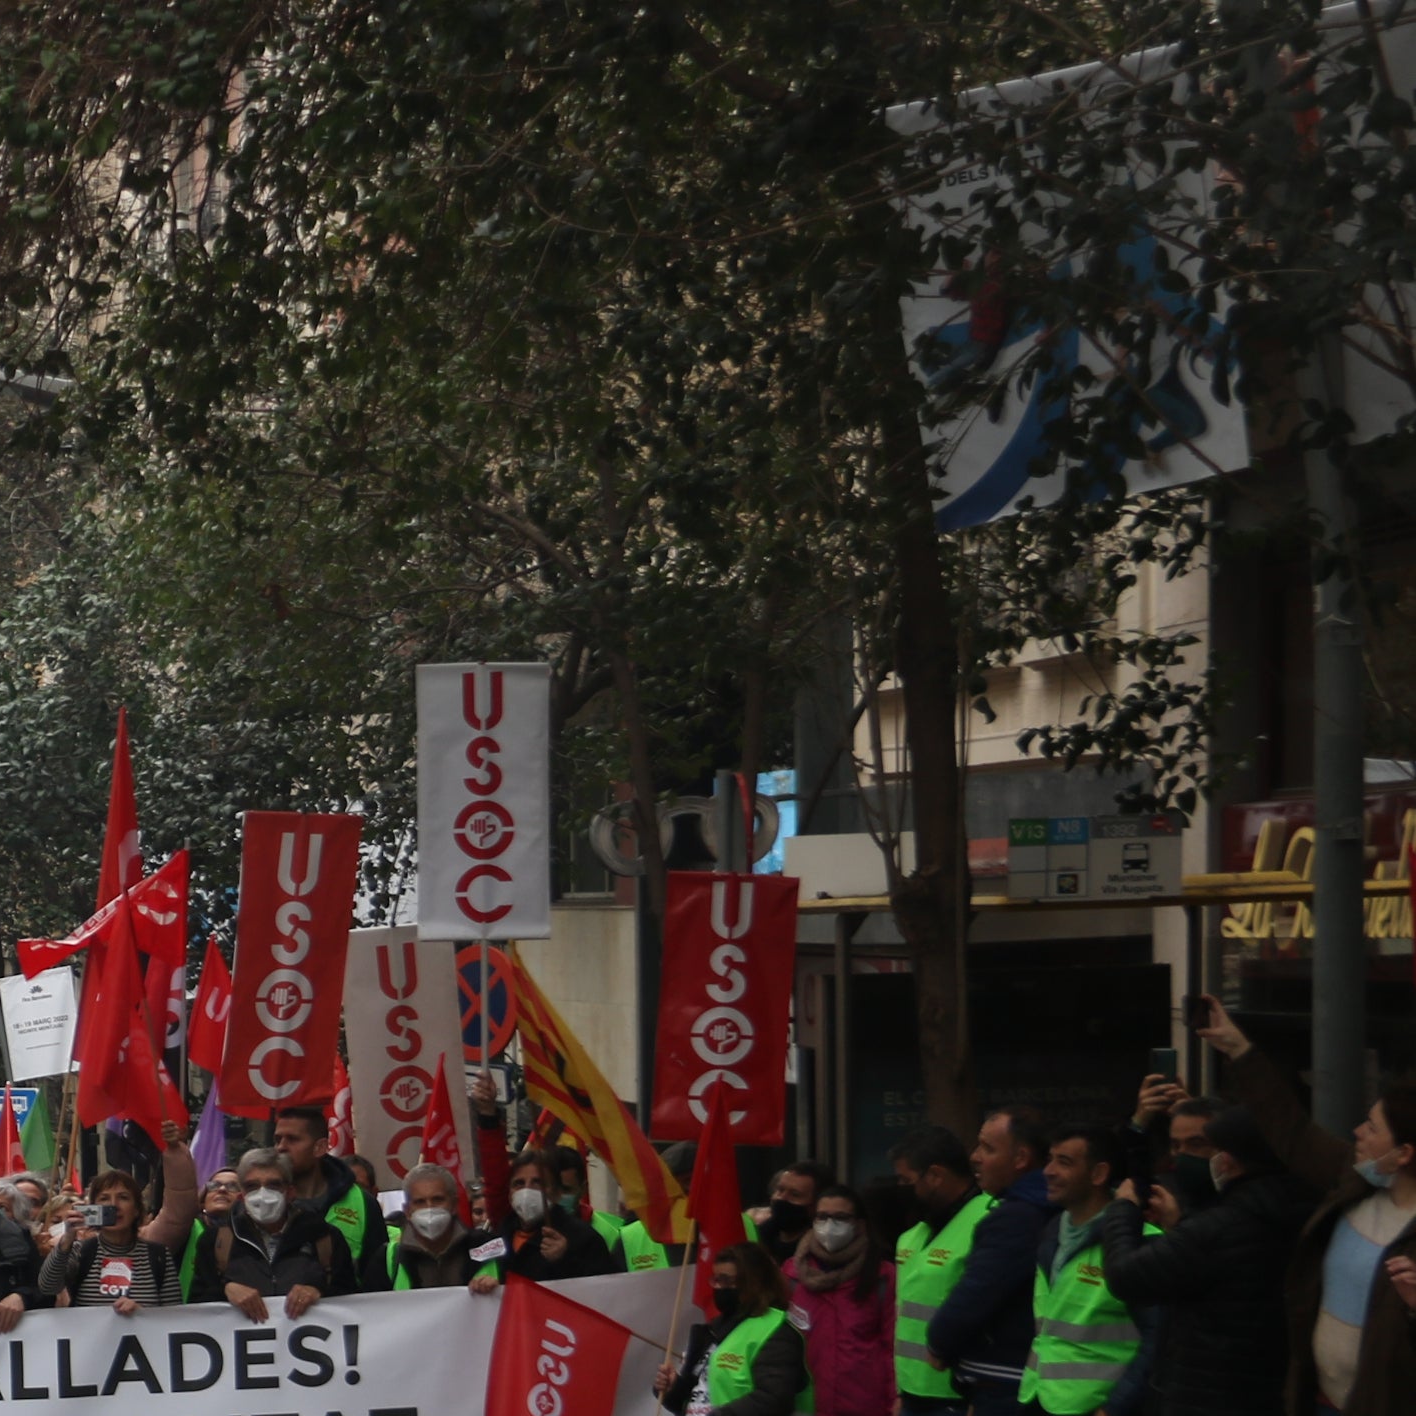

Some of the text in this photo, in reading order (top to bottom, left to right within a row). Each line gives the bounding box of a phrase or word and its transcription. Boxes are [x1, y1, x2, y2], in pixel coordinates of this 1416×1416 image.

[453, 671, 515, 923] USOC
[249, 832, 322, 1099] USOC
[376, 942, 436, 1180] USOC
[688, 881, 754, 1125] USOC
[99, 1283, 130, 1296] CGT
